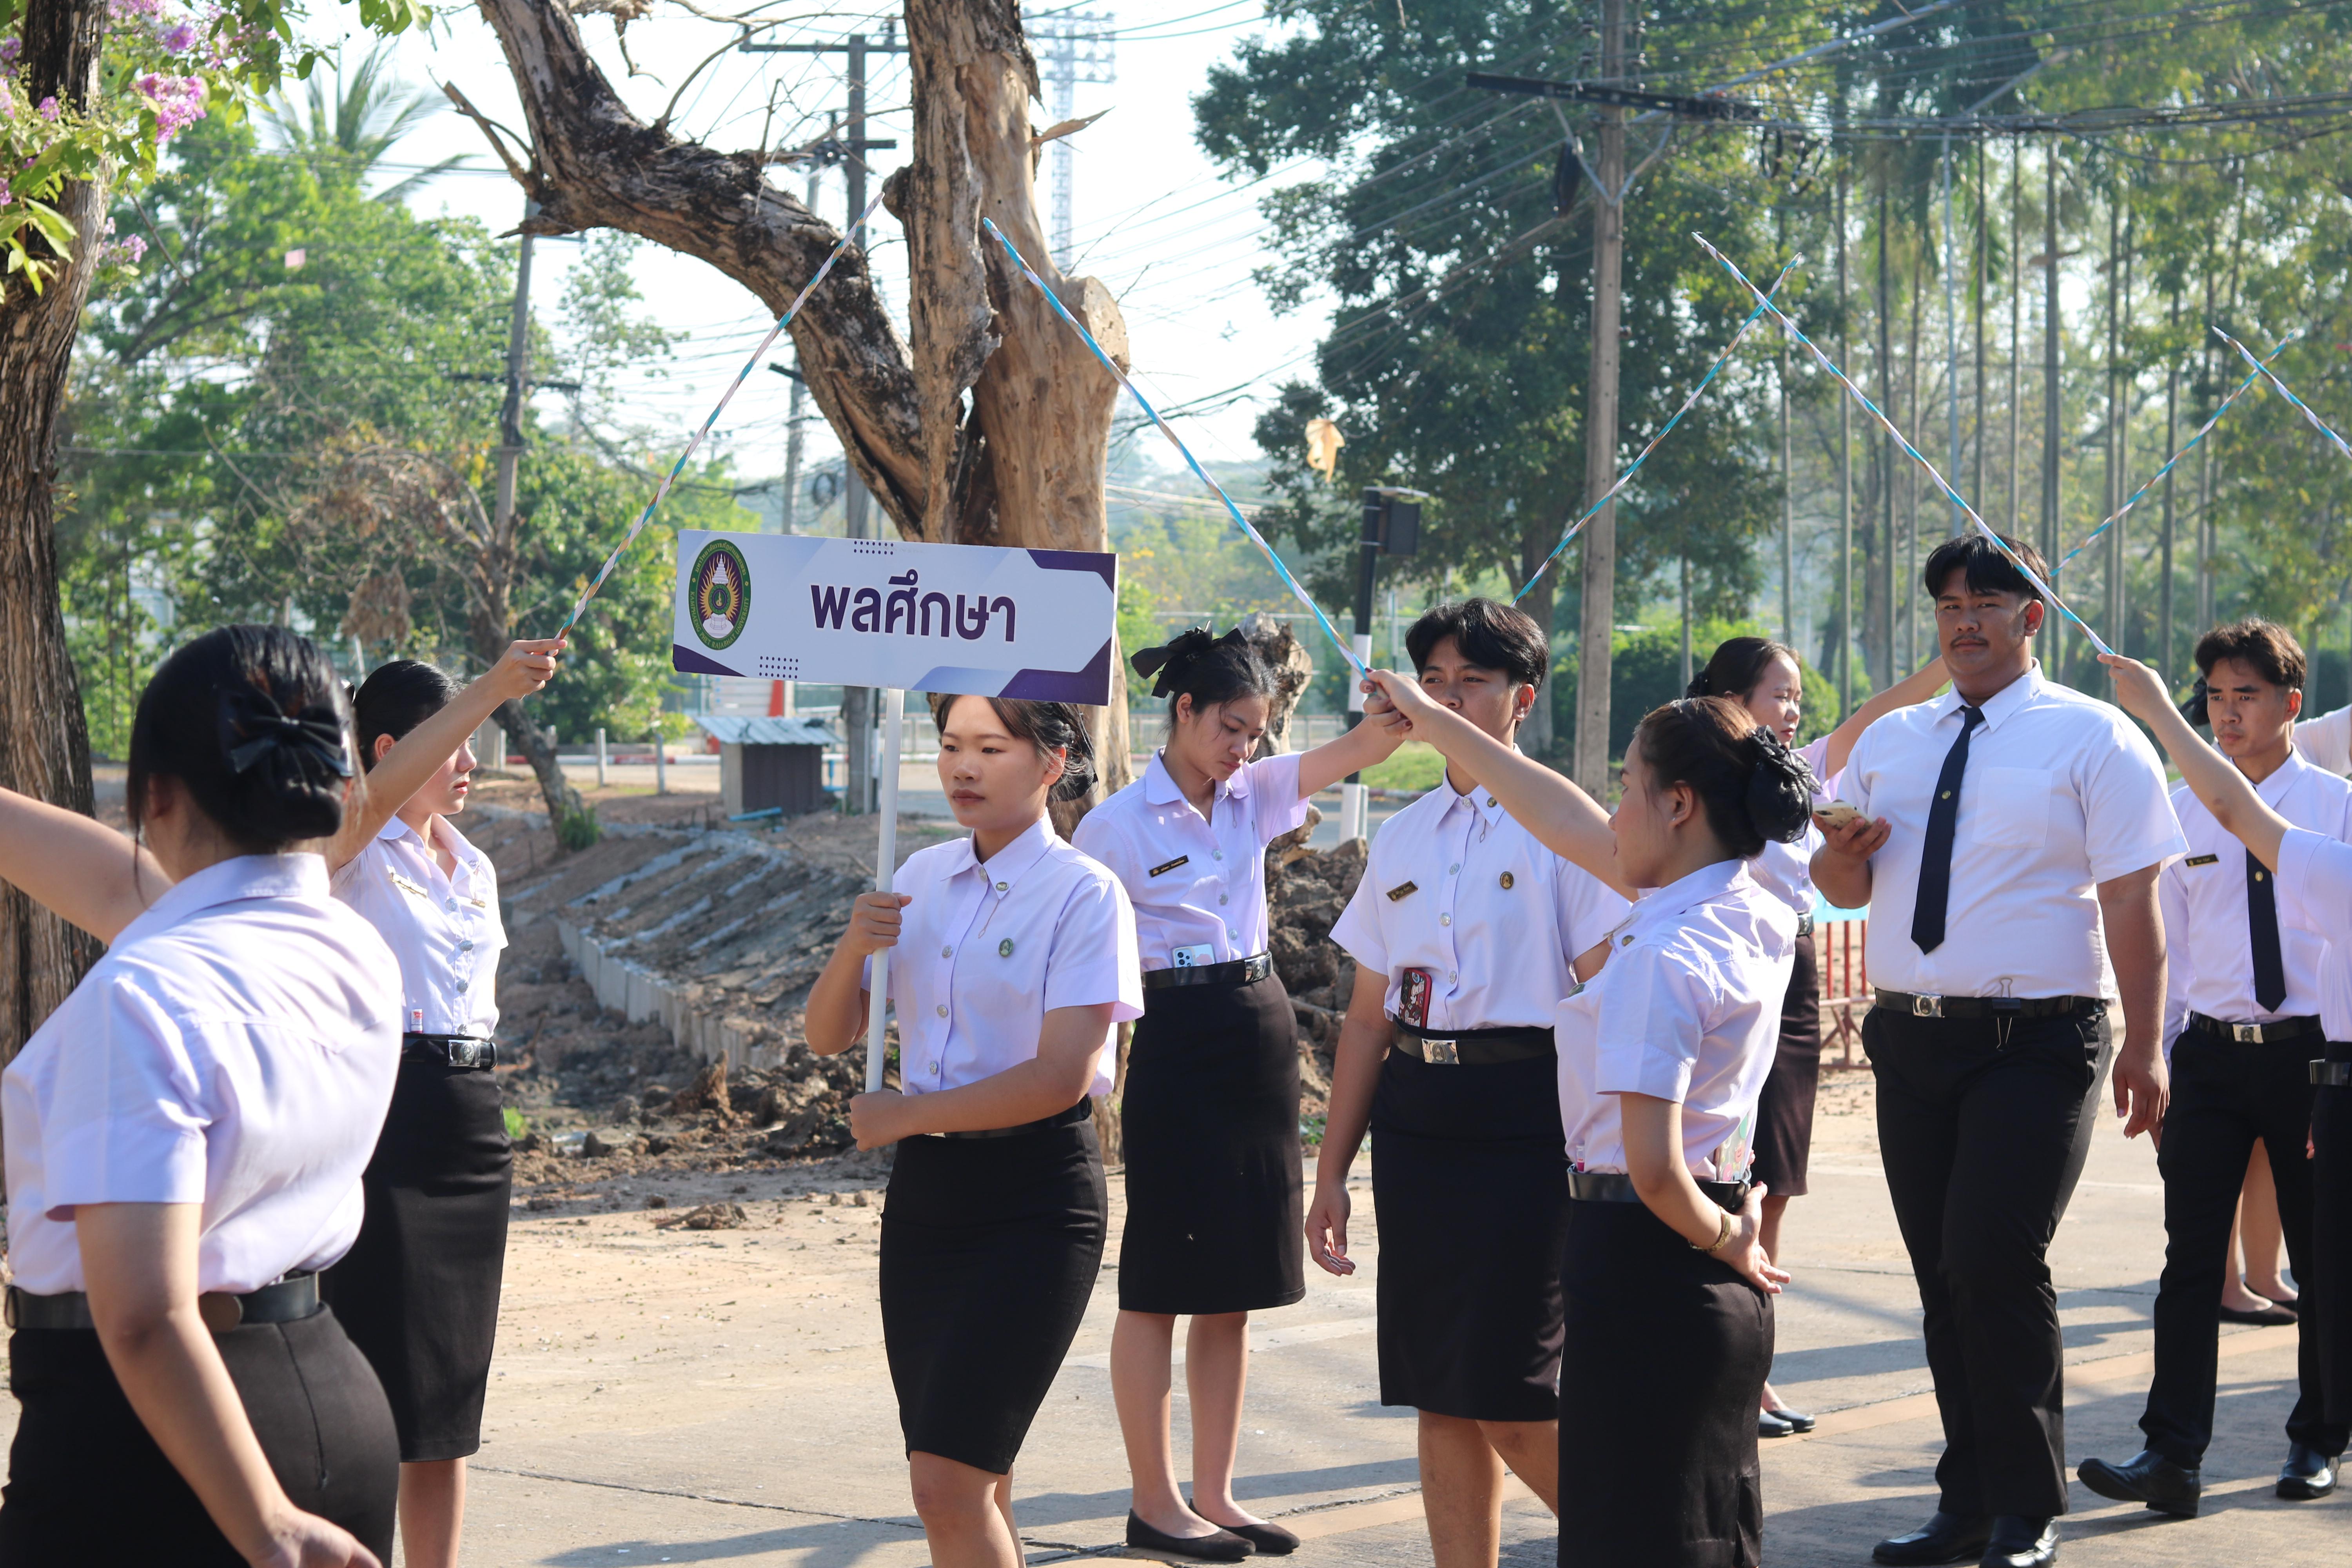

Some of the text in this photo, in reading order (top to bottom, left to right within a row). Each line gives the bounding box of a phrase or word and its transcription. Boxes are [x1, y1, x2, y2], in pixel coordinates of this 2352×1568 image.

[690, 591, 749, 649] KAMPHAENG PHET RAJABHAT UNIVERSITY
[810, 568, 1016, 642] พลศึกษา
